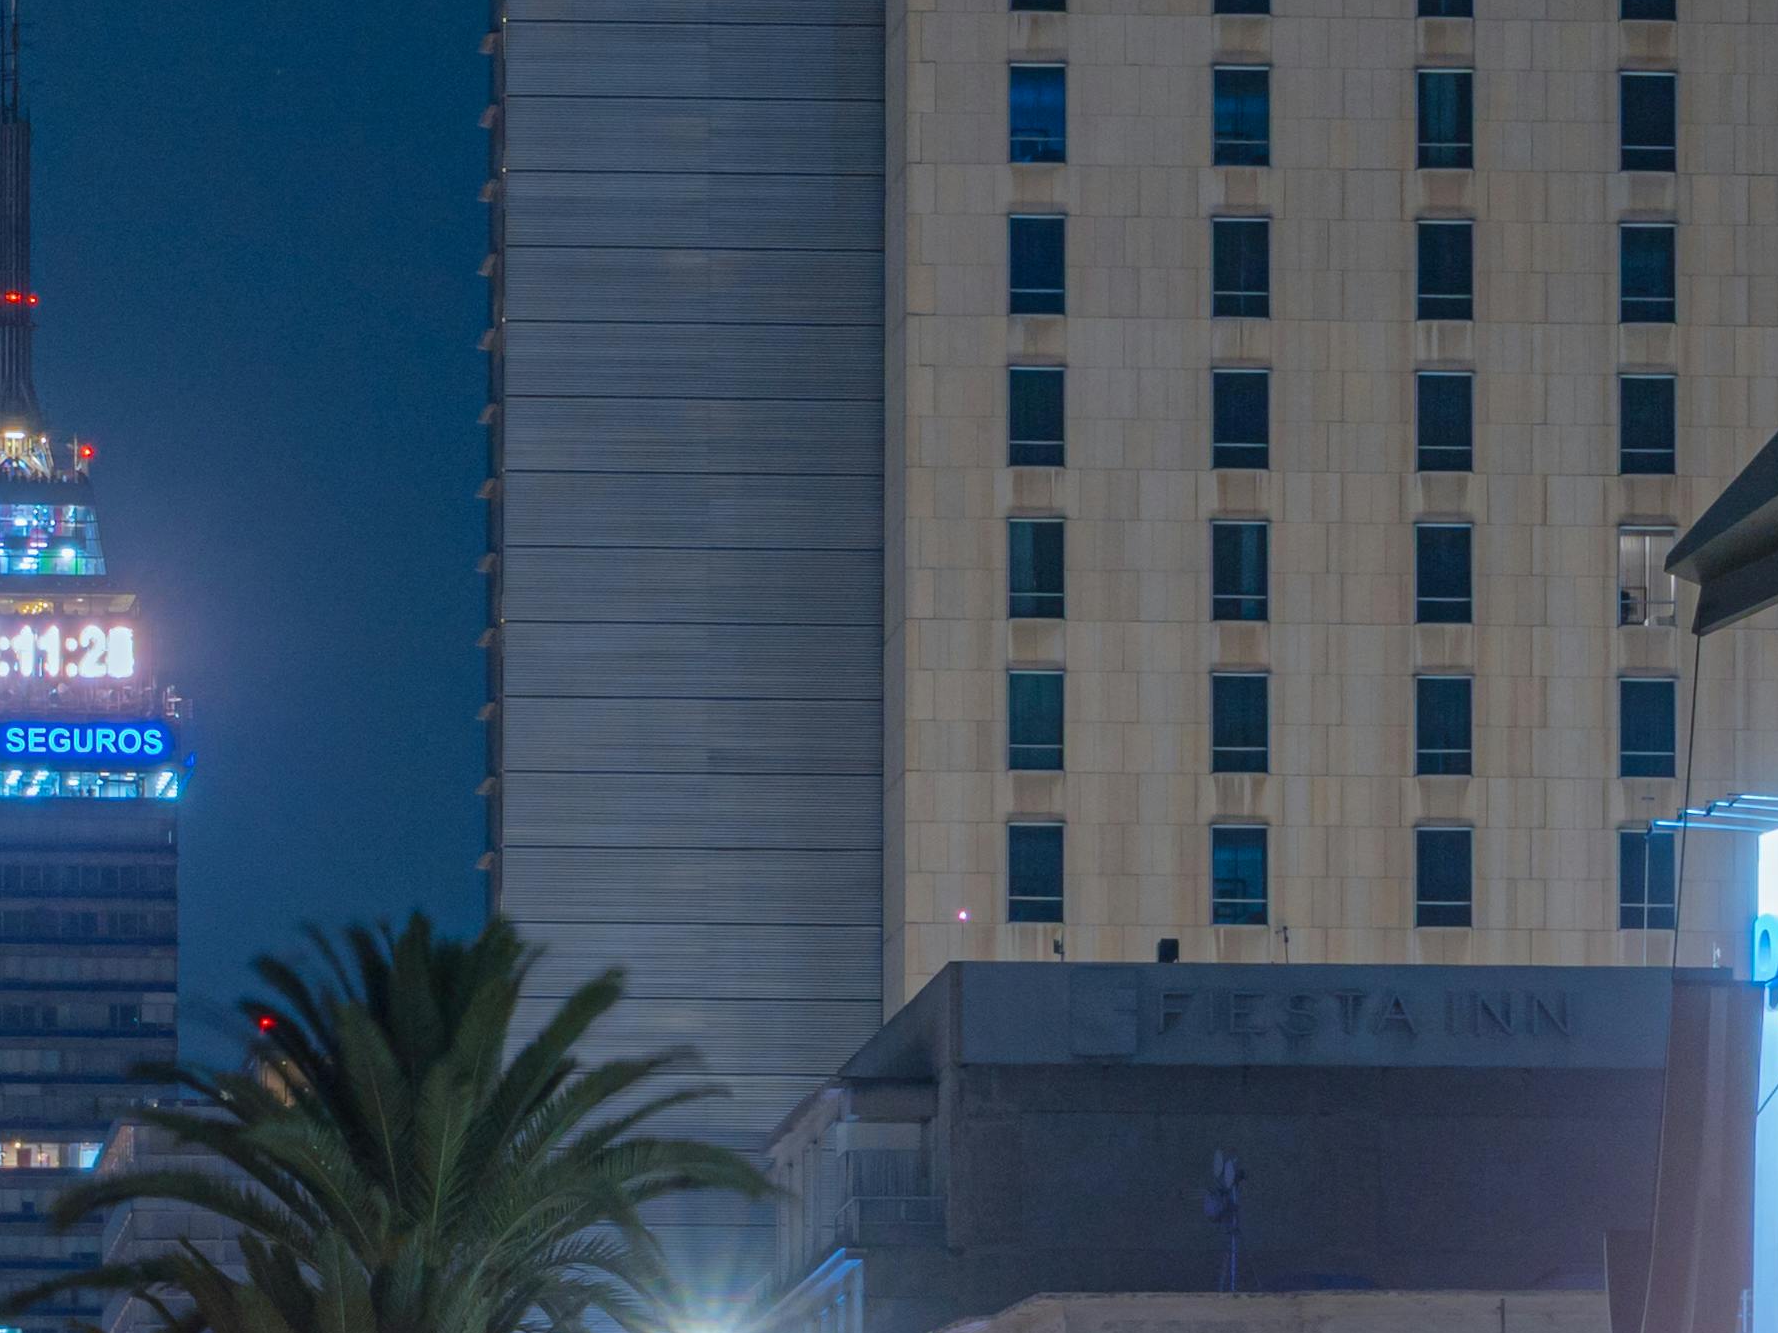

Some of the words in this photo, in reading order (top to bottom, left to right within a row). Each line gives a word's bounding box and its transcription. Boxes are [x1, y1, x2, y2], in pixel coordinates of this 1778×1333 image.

[5, 727, 164, 755] SEGUROS
[1157, 990, 1419, 1037] FIESTA
[1443, 991, 1572, 1038] INN
